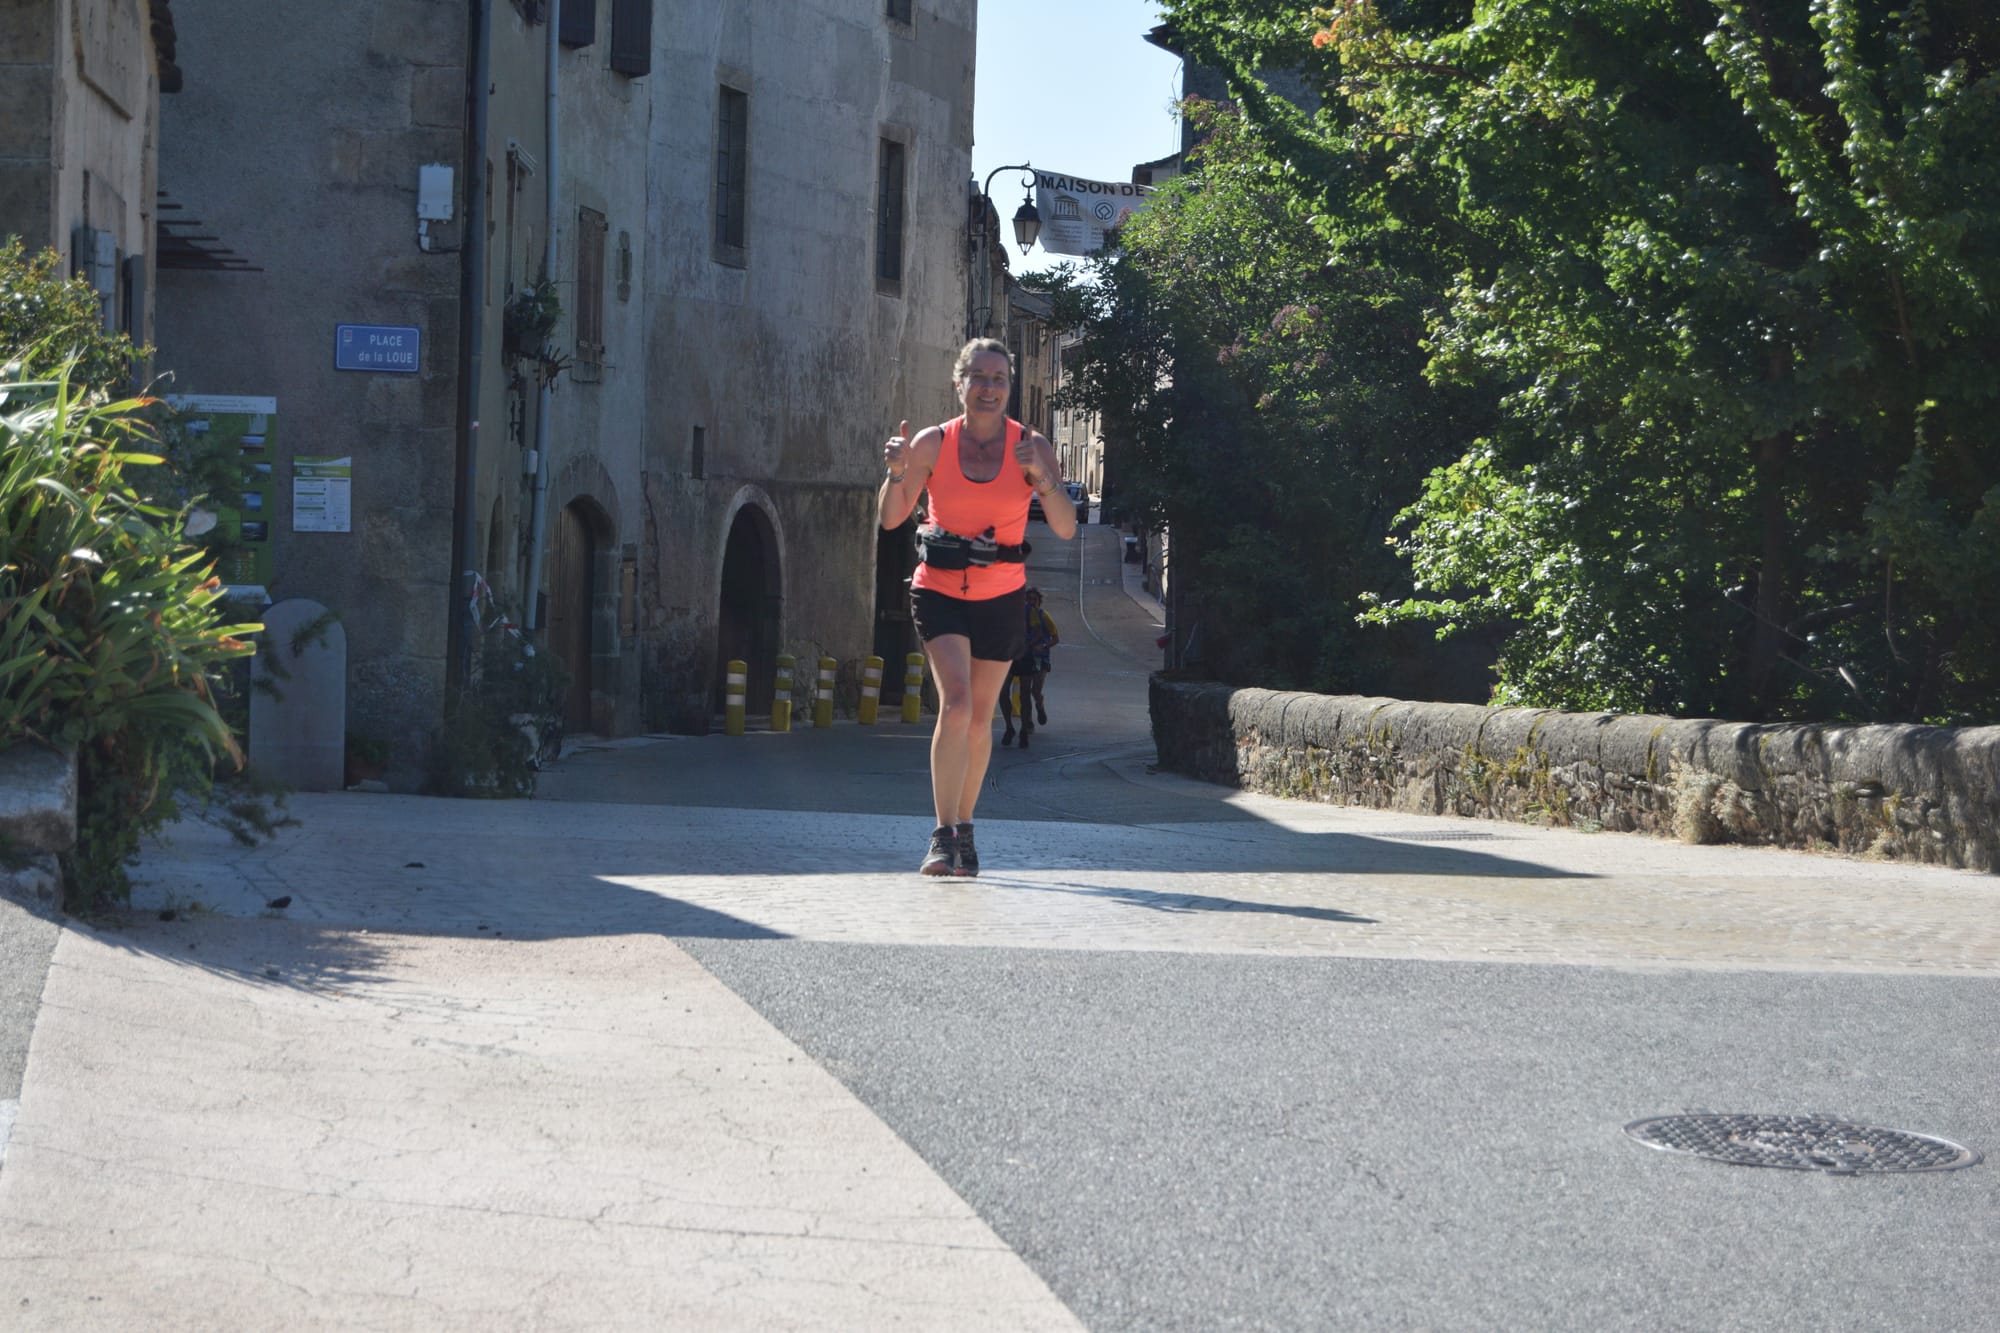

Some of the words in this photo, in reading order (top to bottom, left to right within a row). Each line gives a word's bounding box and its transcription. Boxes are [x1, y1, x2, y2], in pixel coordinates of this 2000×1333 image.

[1041, 175, 1115, 195] MAISON
[1121, 186, 1145, 197] DE
[370, 334, 402, 346] PLACE
[358, 351, 370, 362] de
[374, 351, 383, 362] la
[386, 352, 413, 364] LOUE
